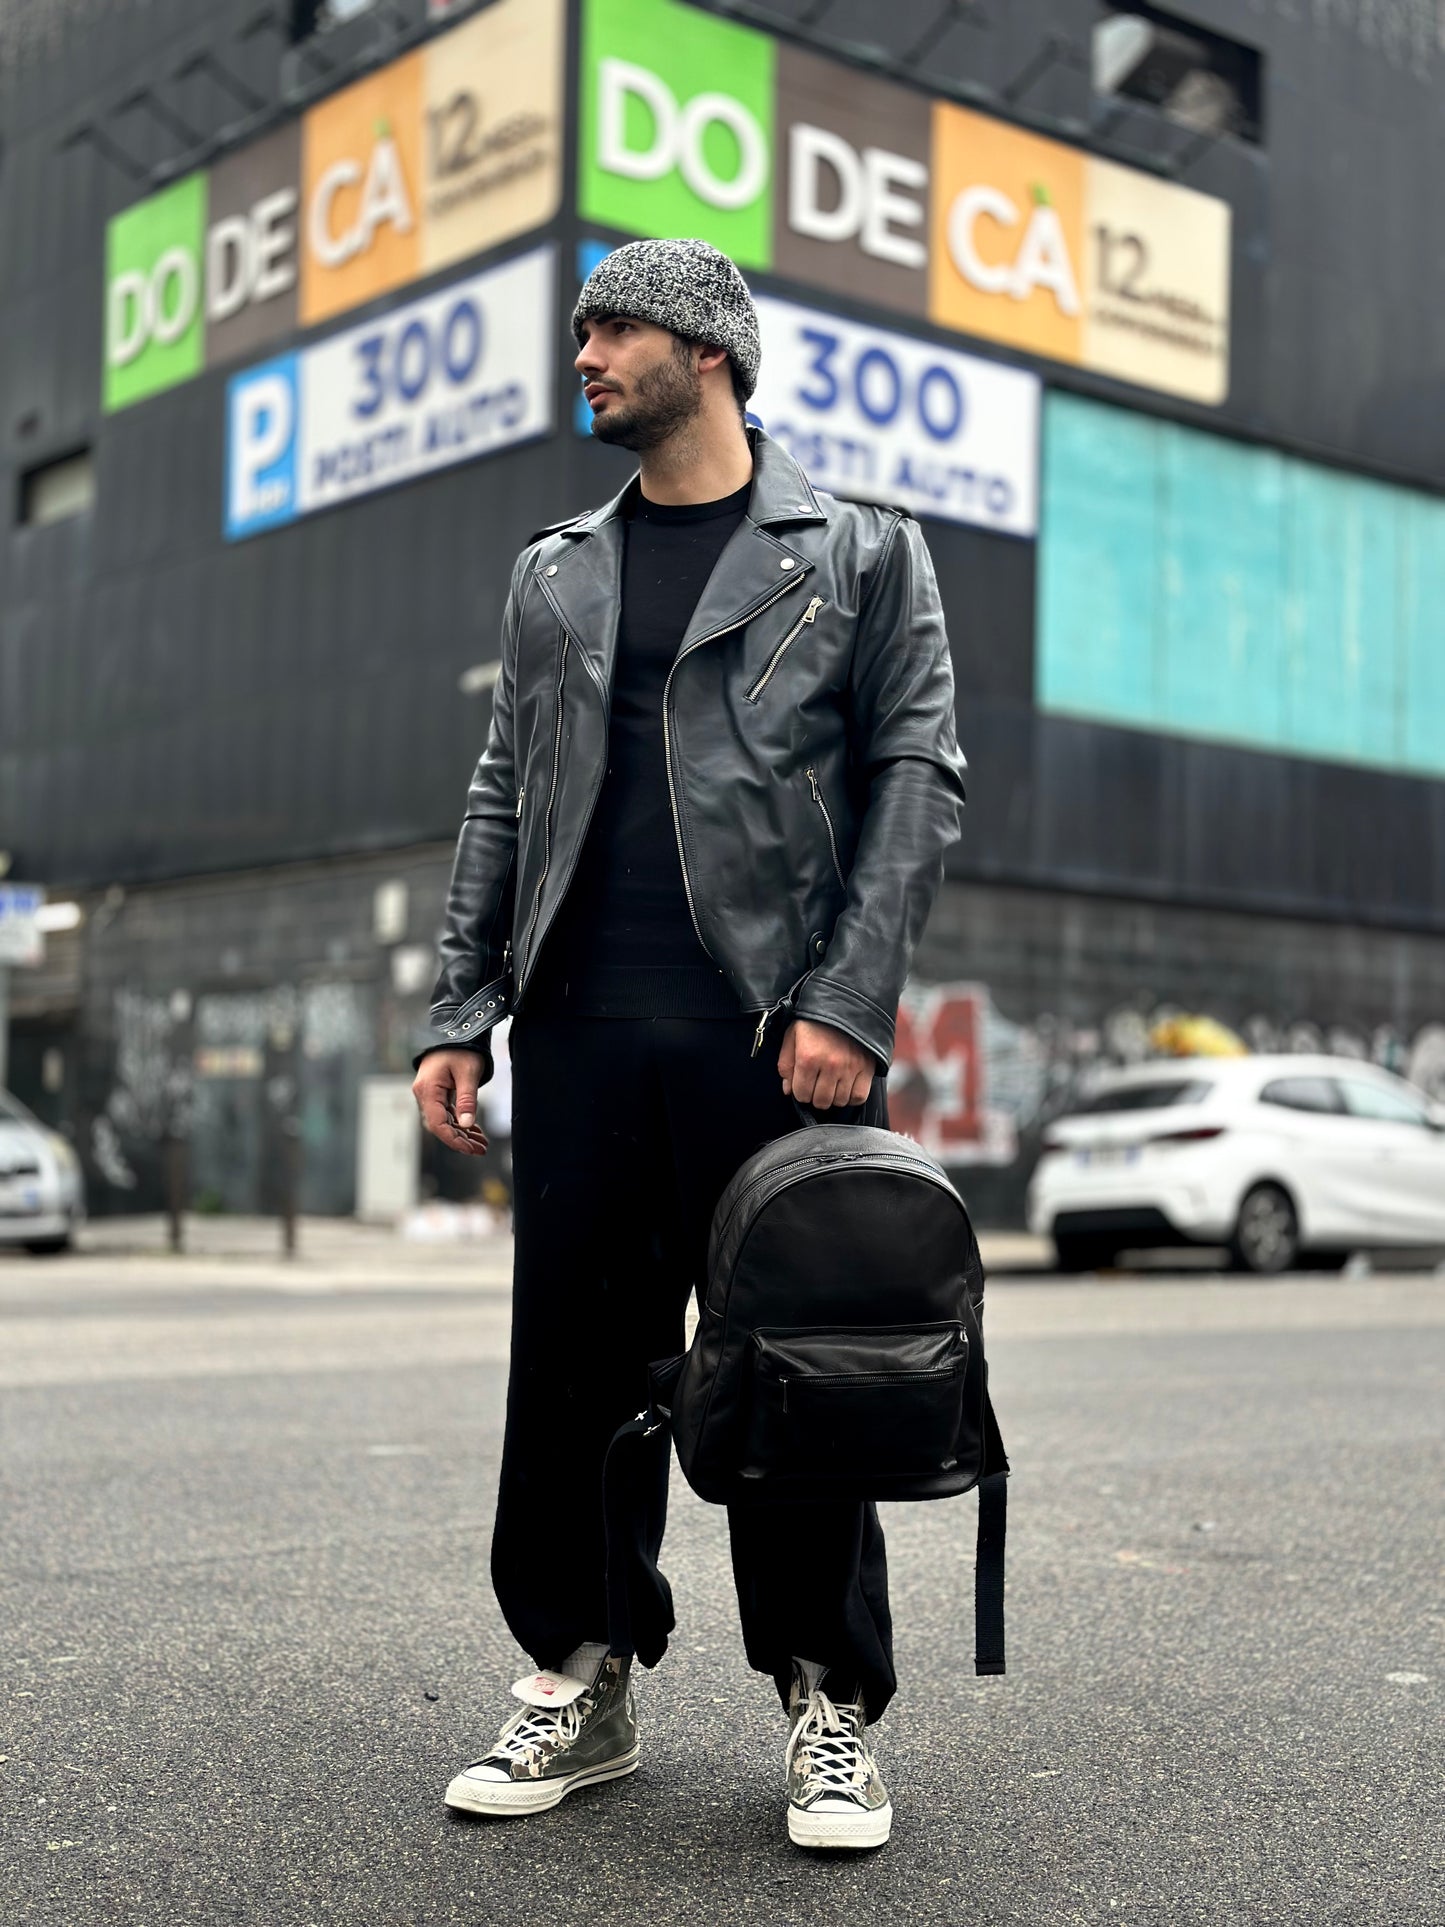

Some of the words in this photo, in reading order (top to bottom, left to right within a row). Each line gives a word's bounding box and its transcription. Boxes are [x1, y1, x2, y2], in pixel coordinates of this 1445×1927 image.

[597, 55, 770, 211] DO
[788, 122, 928, 270] DE
[110, 246, 200, 368] DO
[208, 187, 298, 322] DE
[352, 297, 484, 421] 300
[795, 327, 967, 442] 300
[313, 422, 410, 489] POSTI
[422, 378, 530, 454] AUTO
[746, 411, 877, 482] OSTI
[895, 454, 1014, 516] AUTO
